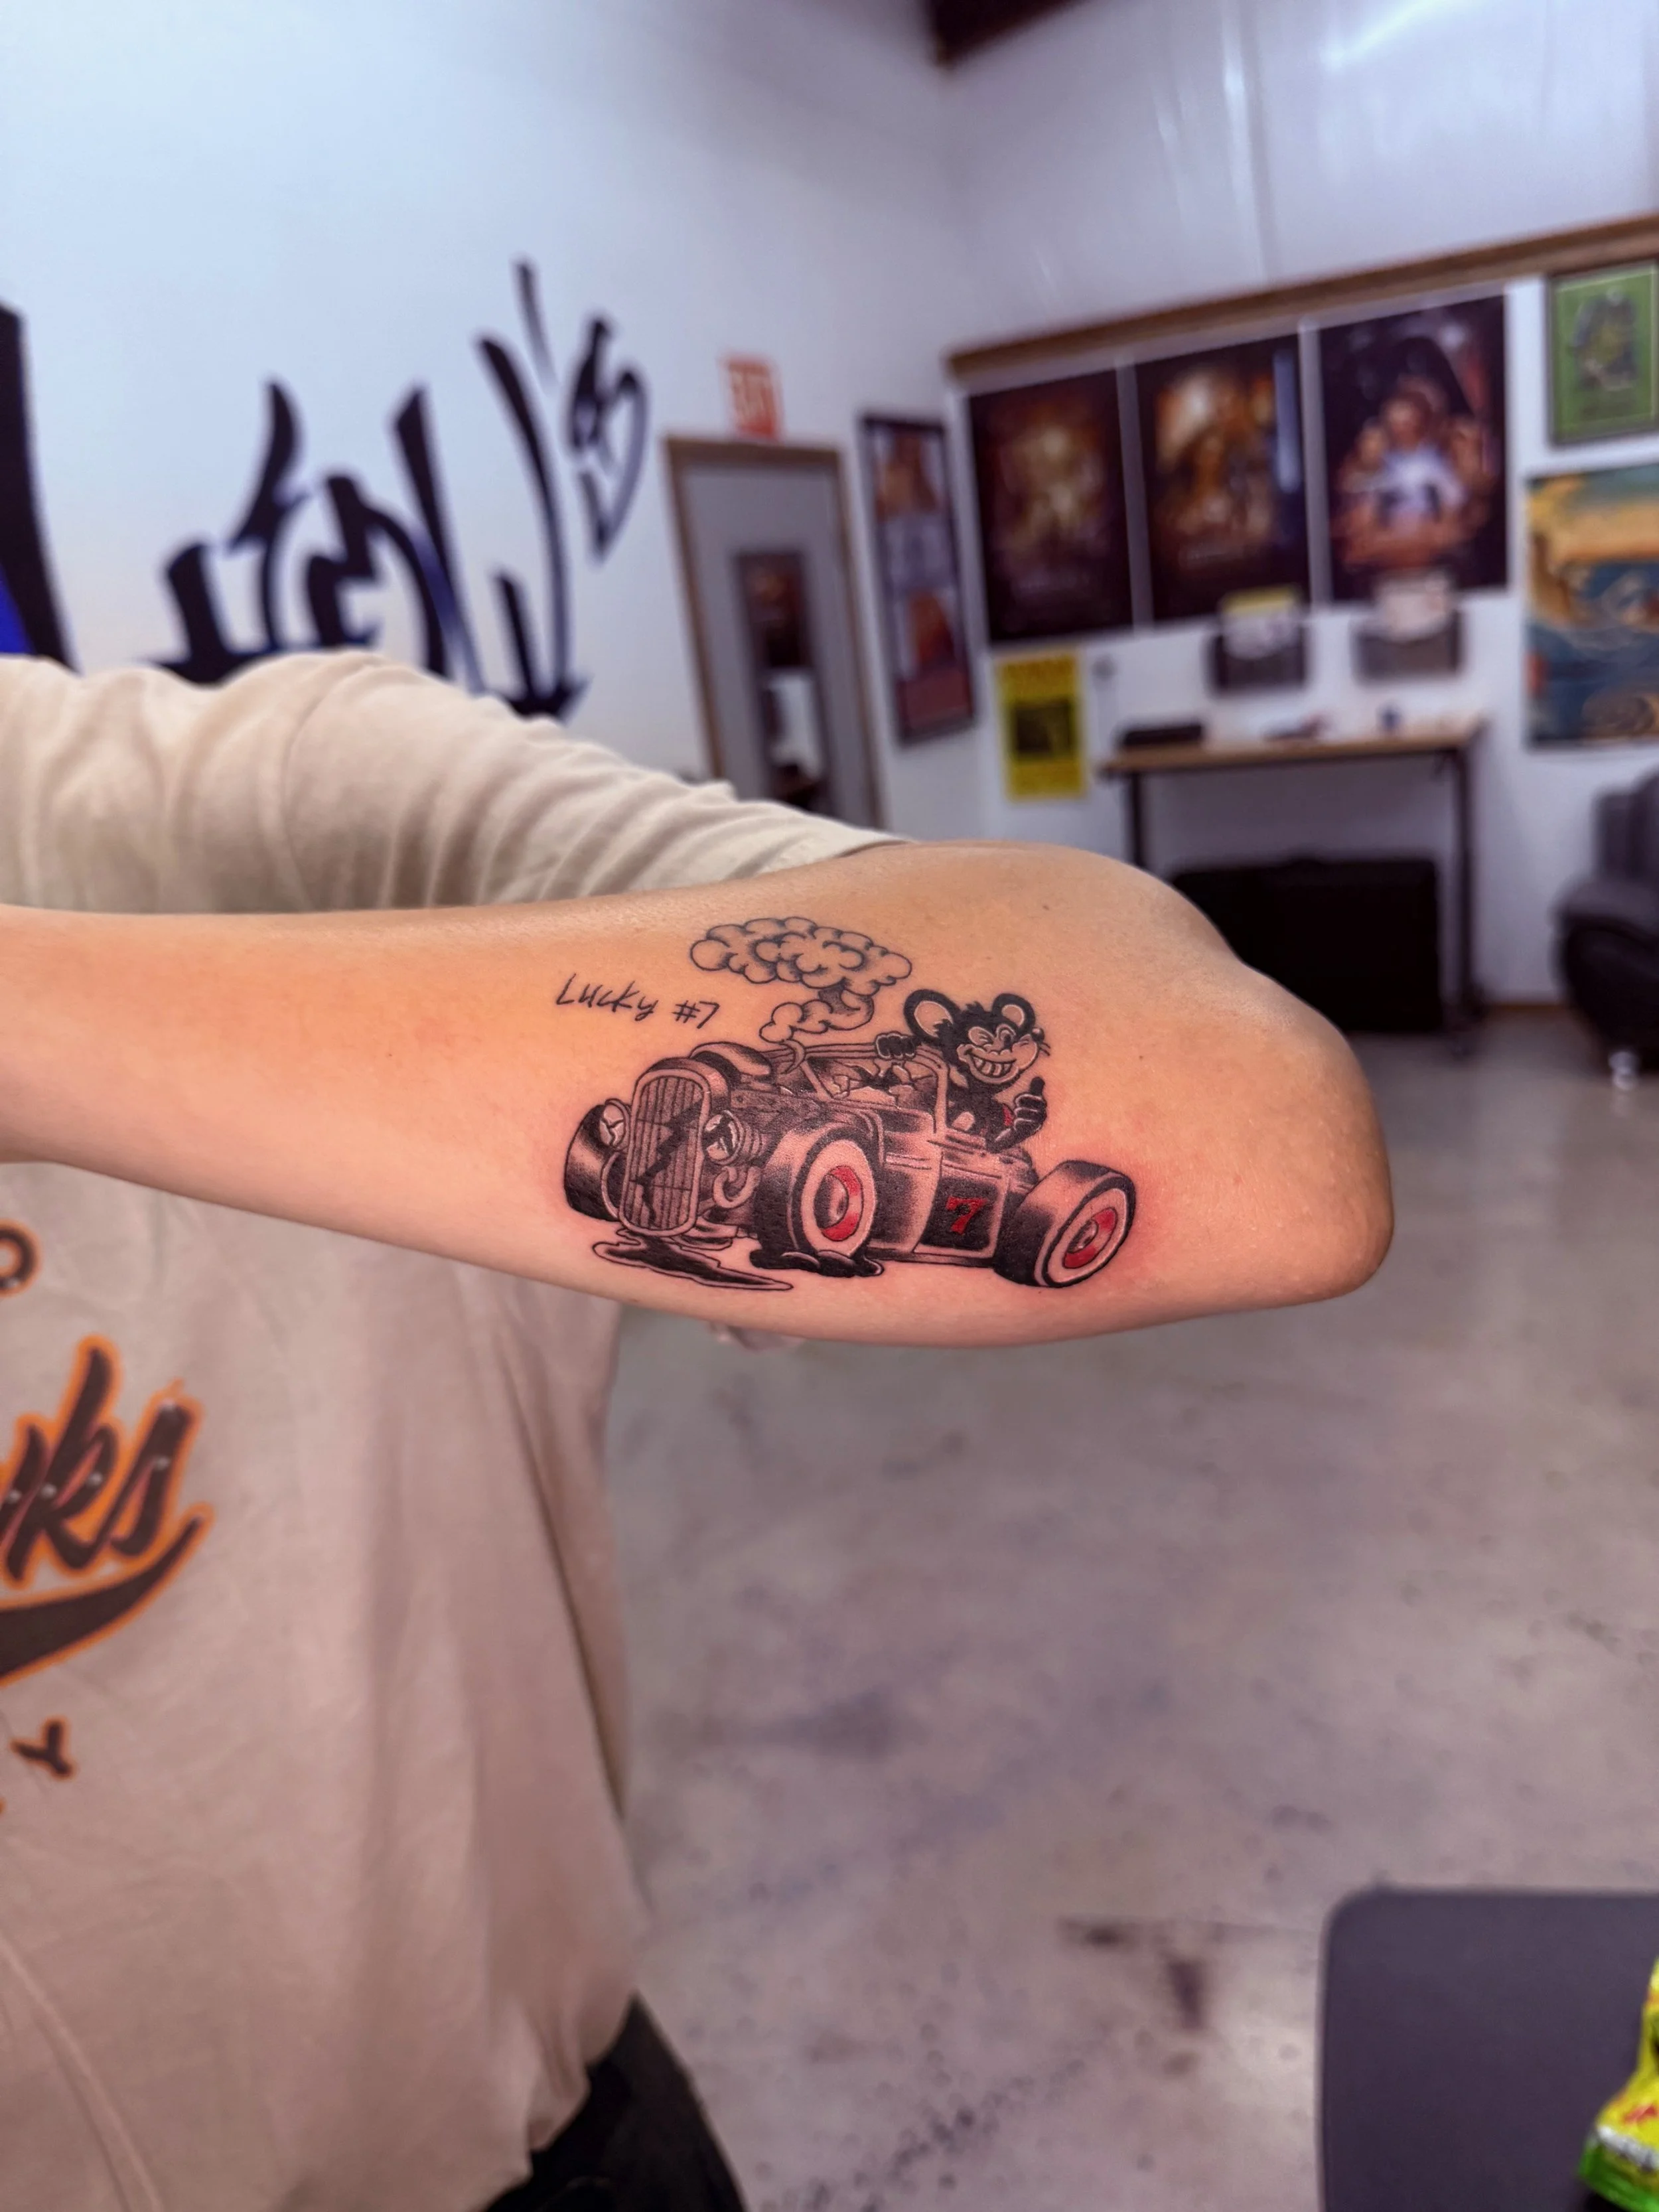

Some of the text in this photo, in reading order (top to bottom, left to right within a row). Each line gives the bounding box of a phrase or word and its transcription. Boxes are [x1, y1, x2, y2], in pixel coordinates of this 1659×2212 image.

[555, 973, 720, 1029] Lucky #7
[945, 1196, 988, 1235] 7
